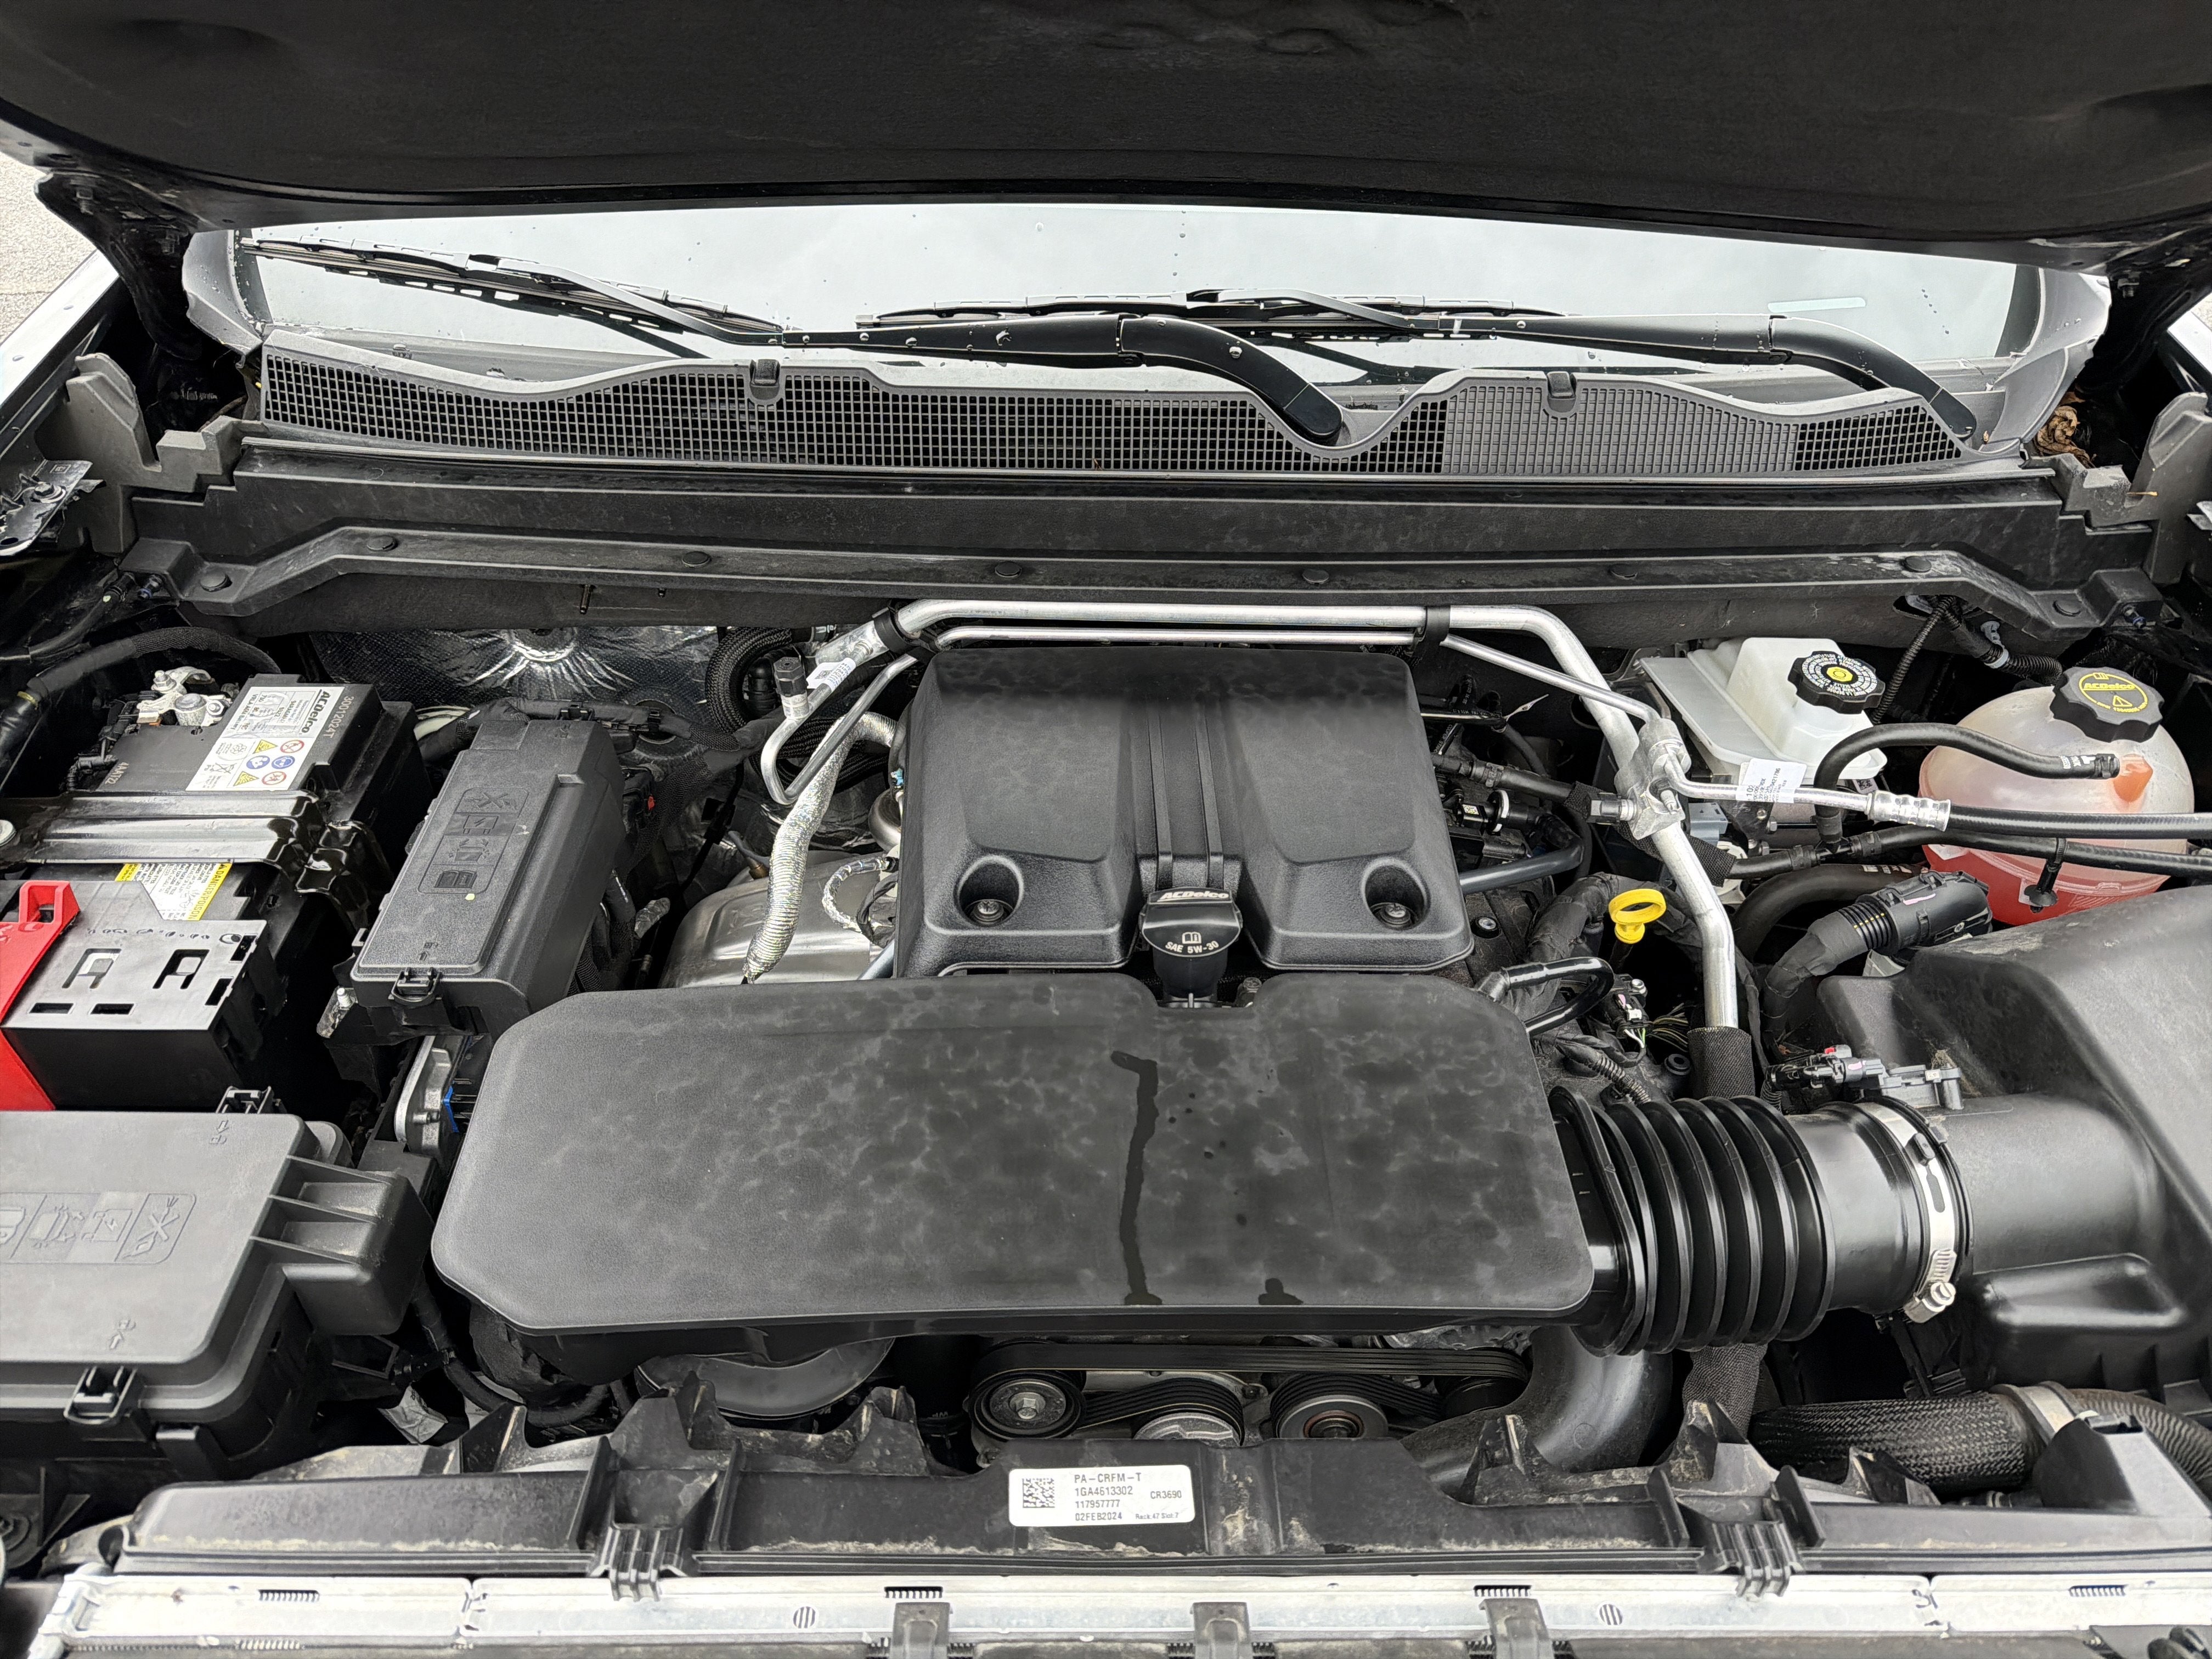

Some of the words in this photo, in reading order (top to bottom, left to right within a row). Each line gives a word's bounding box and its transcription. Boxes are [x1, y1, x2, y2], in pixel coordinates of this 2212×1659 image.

[301, 691, 331, 733] ACDelco
[323, 696, 354, 738] 30012024T
[188, 871, 224, 918] DANGER/POISON
[1160, 891, 1228, 900] ACDelco
[1165, 941, 1183, 953] SAE
[1188, 940, 1219, 953] 5W-30
[1074, 1486, 1133, 1497] 1GA4613302
[1150, 1490, 1182, 1499] CR3690
[1075, 1499, 1120, 1509] 117957777
[1075, 1512, 1122, 1521] 02FEB2024
